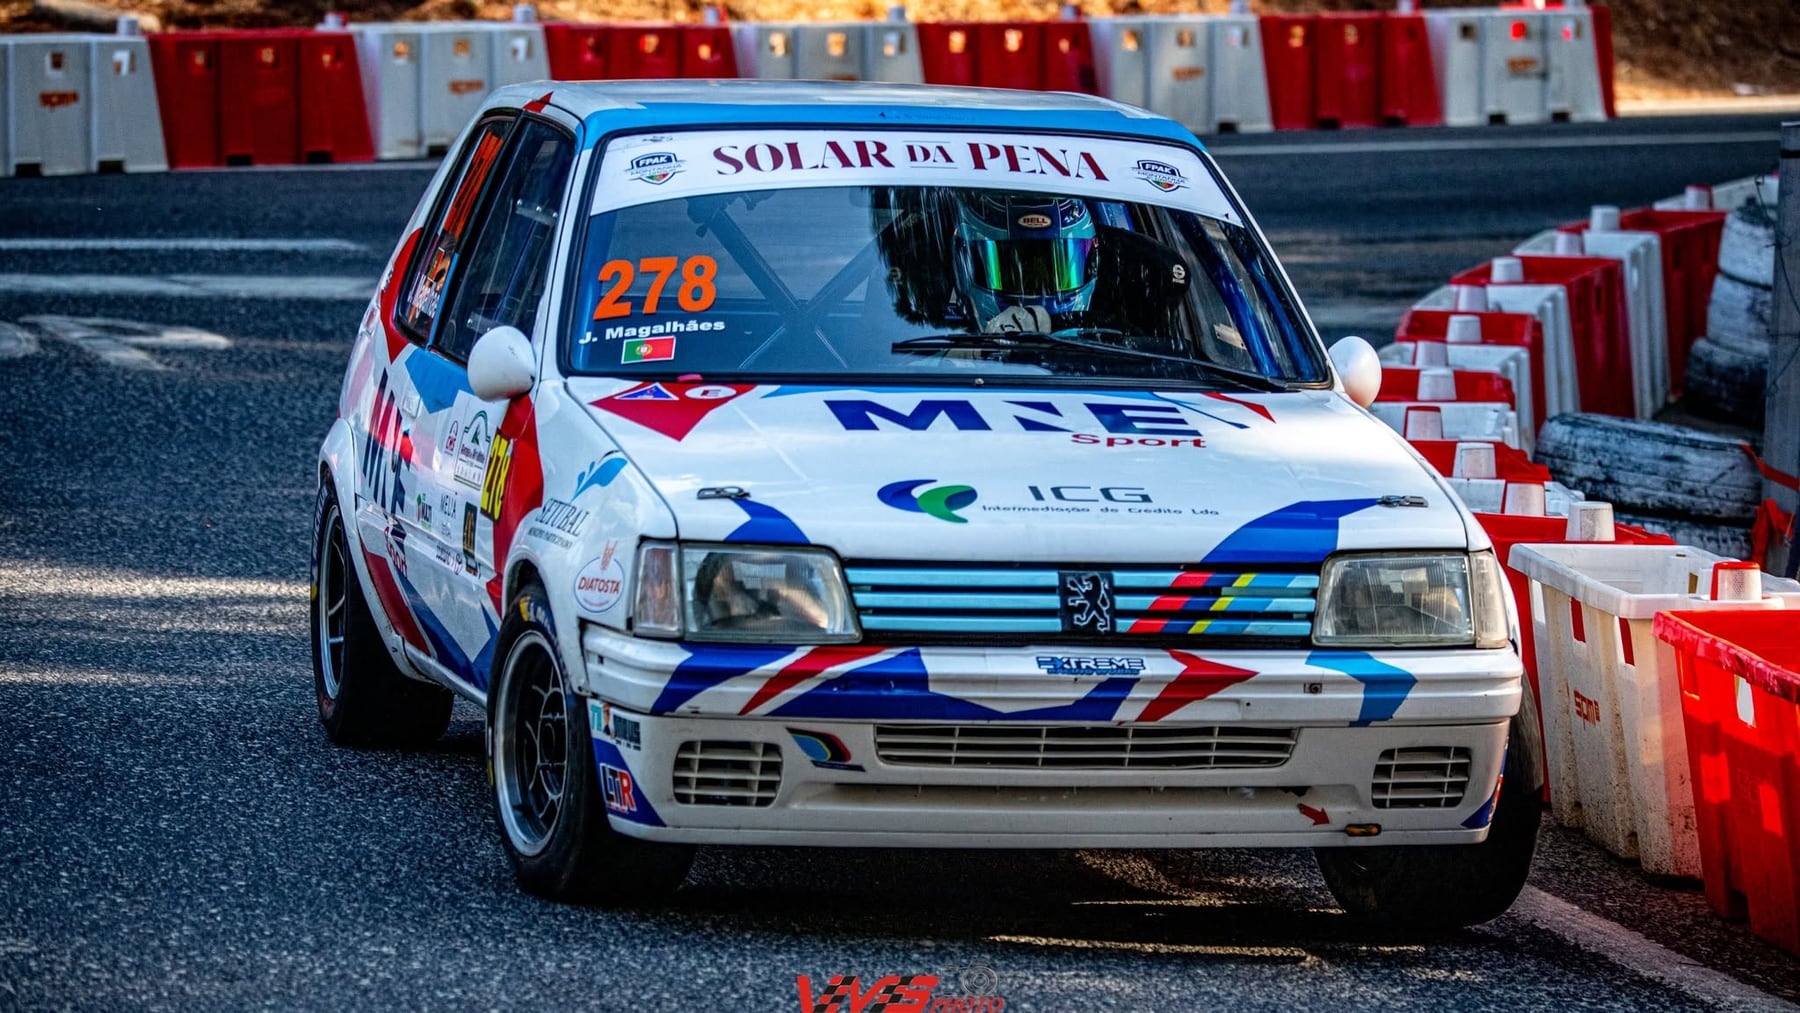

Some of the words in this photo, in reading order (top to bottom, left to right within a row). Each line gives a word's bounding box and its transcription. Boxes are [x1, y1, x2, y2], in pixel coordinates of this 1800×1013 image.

[639, 155, 668, 168] FPAK
[713, 139, 892, 176] SOLAR
[909, 143, 954, 165] DA
[967, 142, 1110, 182] PENA
[1145, 163, 1172, 174] FPAK
[1022, 216, 1049, 224] BELL
[593, 255, 718, 320] 278
[579, 331, 598, 344] J.
[606, 319, 726, 341] Magalhães
[1072, 434, 1207, 448] Sport
[480, 431, 513, 522] 278
[1028, 485, 1154, 503] ICG
[577, 576, 621, 595] DIATOSTA
[1036, 656, 1146, 670] EXTREME
